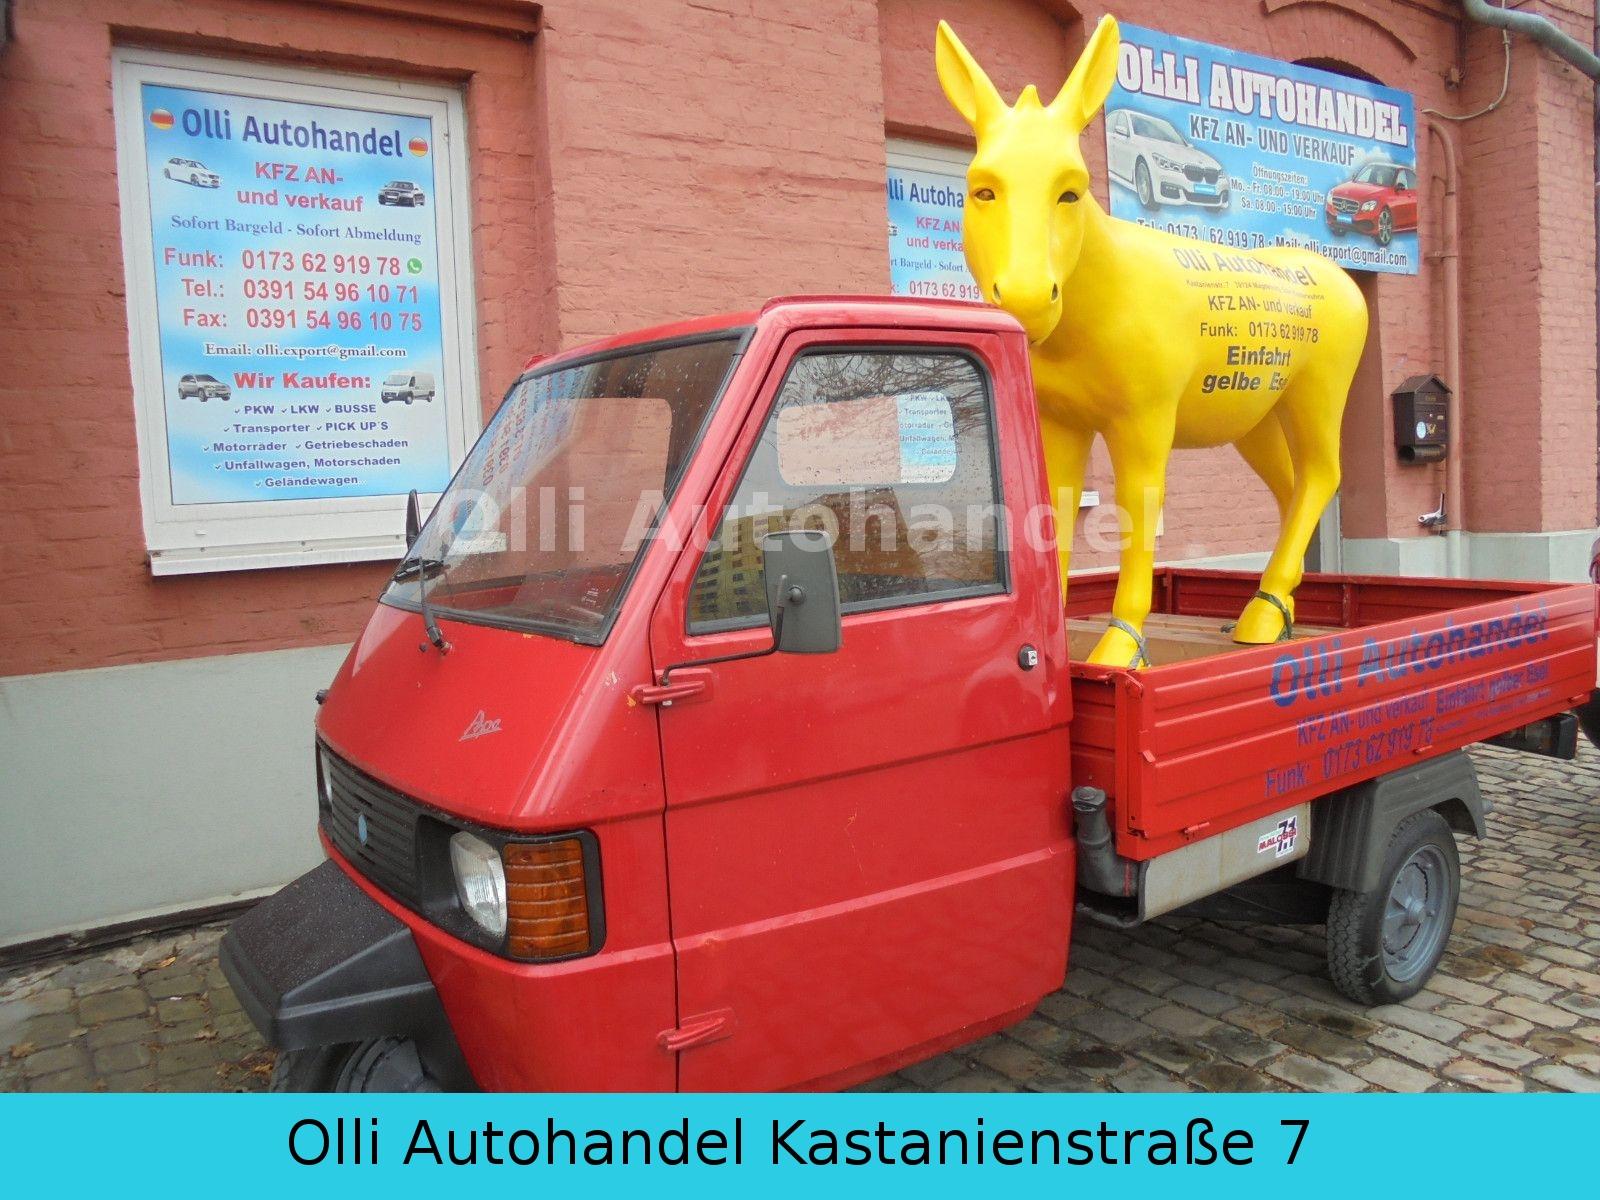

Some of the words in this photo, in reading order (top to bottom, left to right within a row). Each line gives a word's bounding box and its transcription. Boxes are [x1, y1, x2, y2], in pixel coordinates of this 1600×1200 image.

[1116, 40, 1201, 105] OLLI
[1209, 61, 1408, 146] AUTOHANDEL
[182, 108, 232, 140] Olli
[242, 116, 403, 157] Autohandel
[1190, 115, 1219, 140] KFZ
[1225, 122, 1252, 147] AN-
[1258, 127, 1288, 155] UND
[1294, 134, 1355, 166] VERKAUF
[255, 161, 298, 182] KFZ
[305, 166, 344, 184] AN-
[237, 189, 279, 206] und
[285, 193, 364, 212] verkauf
[885, 178, 904, 201] lli
[909, 182, 964, 208] Autoha
[1231, 178, 1245, 192] Mo.
[1263, 184, 1284, 197] 08.00
[1312, 191, 1325, 204] Uhr
[1241, 196, 1253, 208] Sa.
[1255, 199, 1276, 212] 08.00
[1304, 206, 1316, 218] Uhr
[171, 215, 219, 231] Sofort
[226, 218, 283, 236] Bargeld
[296, 224, 340, 239] Sofort
[345, 226, 422, 245] Abmeldung
[916, 216, 940, 230] KFZ
[906, 237, 929, 248] und
[932, 238, 964, 252] verka
[1209, 227, 1224, 245] 62
[1227, 230, 1248, 248] 919
[1252, 233, 1265, 249] 78
[164, 247, 224, 268] Funk:
[242, 249, 295, 272] 0173
[302, 252, 326, 273] 62
[334, 254, 370, 275] 919
[377, 256, 400, 276] 78
[900, 257, 932, 270] Bargeld
[938, 260, 963, 273] Sofort
[1173, 247, 1211, 271] Olli
[1216, 253, 1318, 286] Autohandel
[181, 278, 224, 298] Tel.:
[243, 279, 295, 300] 0391
[303, 281, 329, 301] 54
[334, 282, 360, 303] 96
[366, 283, 390, 303] 10
[396, 284, 419, 304] 71
[909, 280, 938, 296] 0173
[942, 283, 956, 298] 62
[959, 284, 981, 299] 919
[1207, 295, 1236, 311] KFZ
[1239, 296, 1260, 311] AN-
[1263, 298, 1282, 313] und
[1284, 302, 1312, 319] verkauf
[183, 308, 227, 328] Fax:
[246, 309, 297, 329] 0391
[306, 310, 331, 330] 54
[336, 311, 362, 331] 96
[369, 311, 392, 331] 10
[398, 312, 421, 331] 75
[1200, 322, 1238, 337] Funk:
[1249, 321, 1277, 338] 0173
[1280, 323, 1291, 340] 62
[1291, 325, 1305, 341] 919
[1306, 327, 1319, 344] 78
[205, 343, 252, 356] Email:
[256, 344, 408, 360] olli.export@gmail.com
[1226, 346, 1291, 367] Einfahrt
[234, 372, 275, 390] Wir
[283, 372, 371, 390] Kaufen:
[1201, 371, 1261, 394] gelbe
[244, 405, 275, 415] PKW
[290, 404, 319, 414] LKW
[335, 404, 377, 414] BUSSE
[233, 422, 310, 435] Transporter
[325, 422, 356, 431] PICK
[305, 439, 408, 450] Getriebeschaden
[224, 459, 310, 471] Unfallwagen,
[314, 456, 401, 468] Motorschaden
[1270, 637, 1343, 707] Olli
[1358, 601, 1549, 687] Autohandel
[1296, 714, 1326, 746] KFZ
[1330, 711, 1355, 736] AN-
[1358, 698, 1382, 728] und
[1385, 689, 1431, 718] verkauf
[1264, 761, 1312, 797] Funk:
[1323, 738, 1362, 779] 0173
[1366, 731, 1386, 764] 62
[1388, 721, 1415, 757] 919
[1419, 716, 1436, 744] 78
